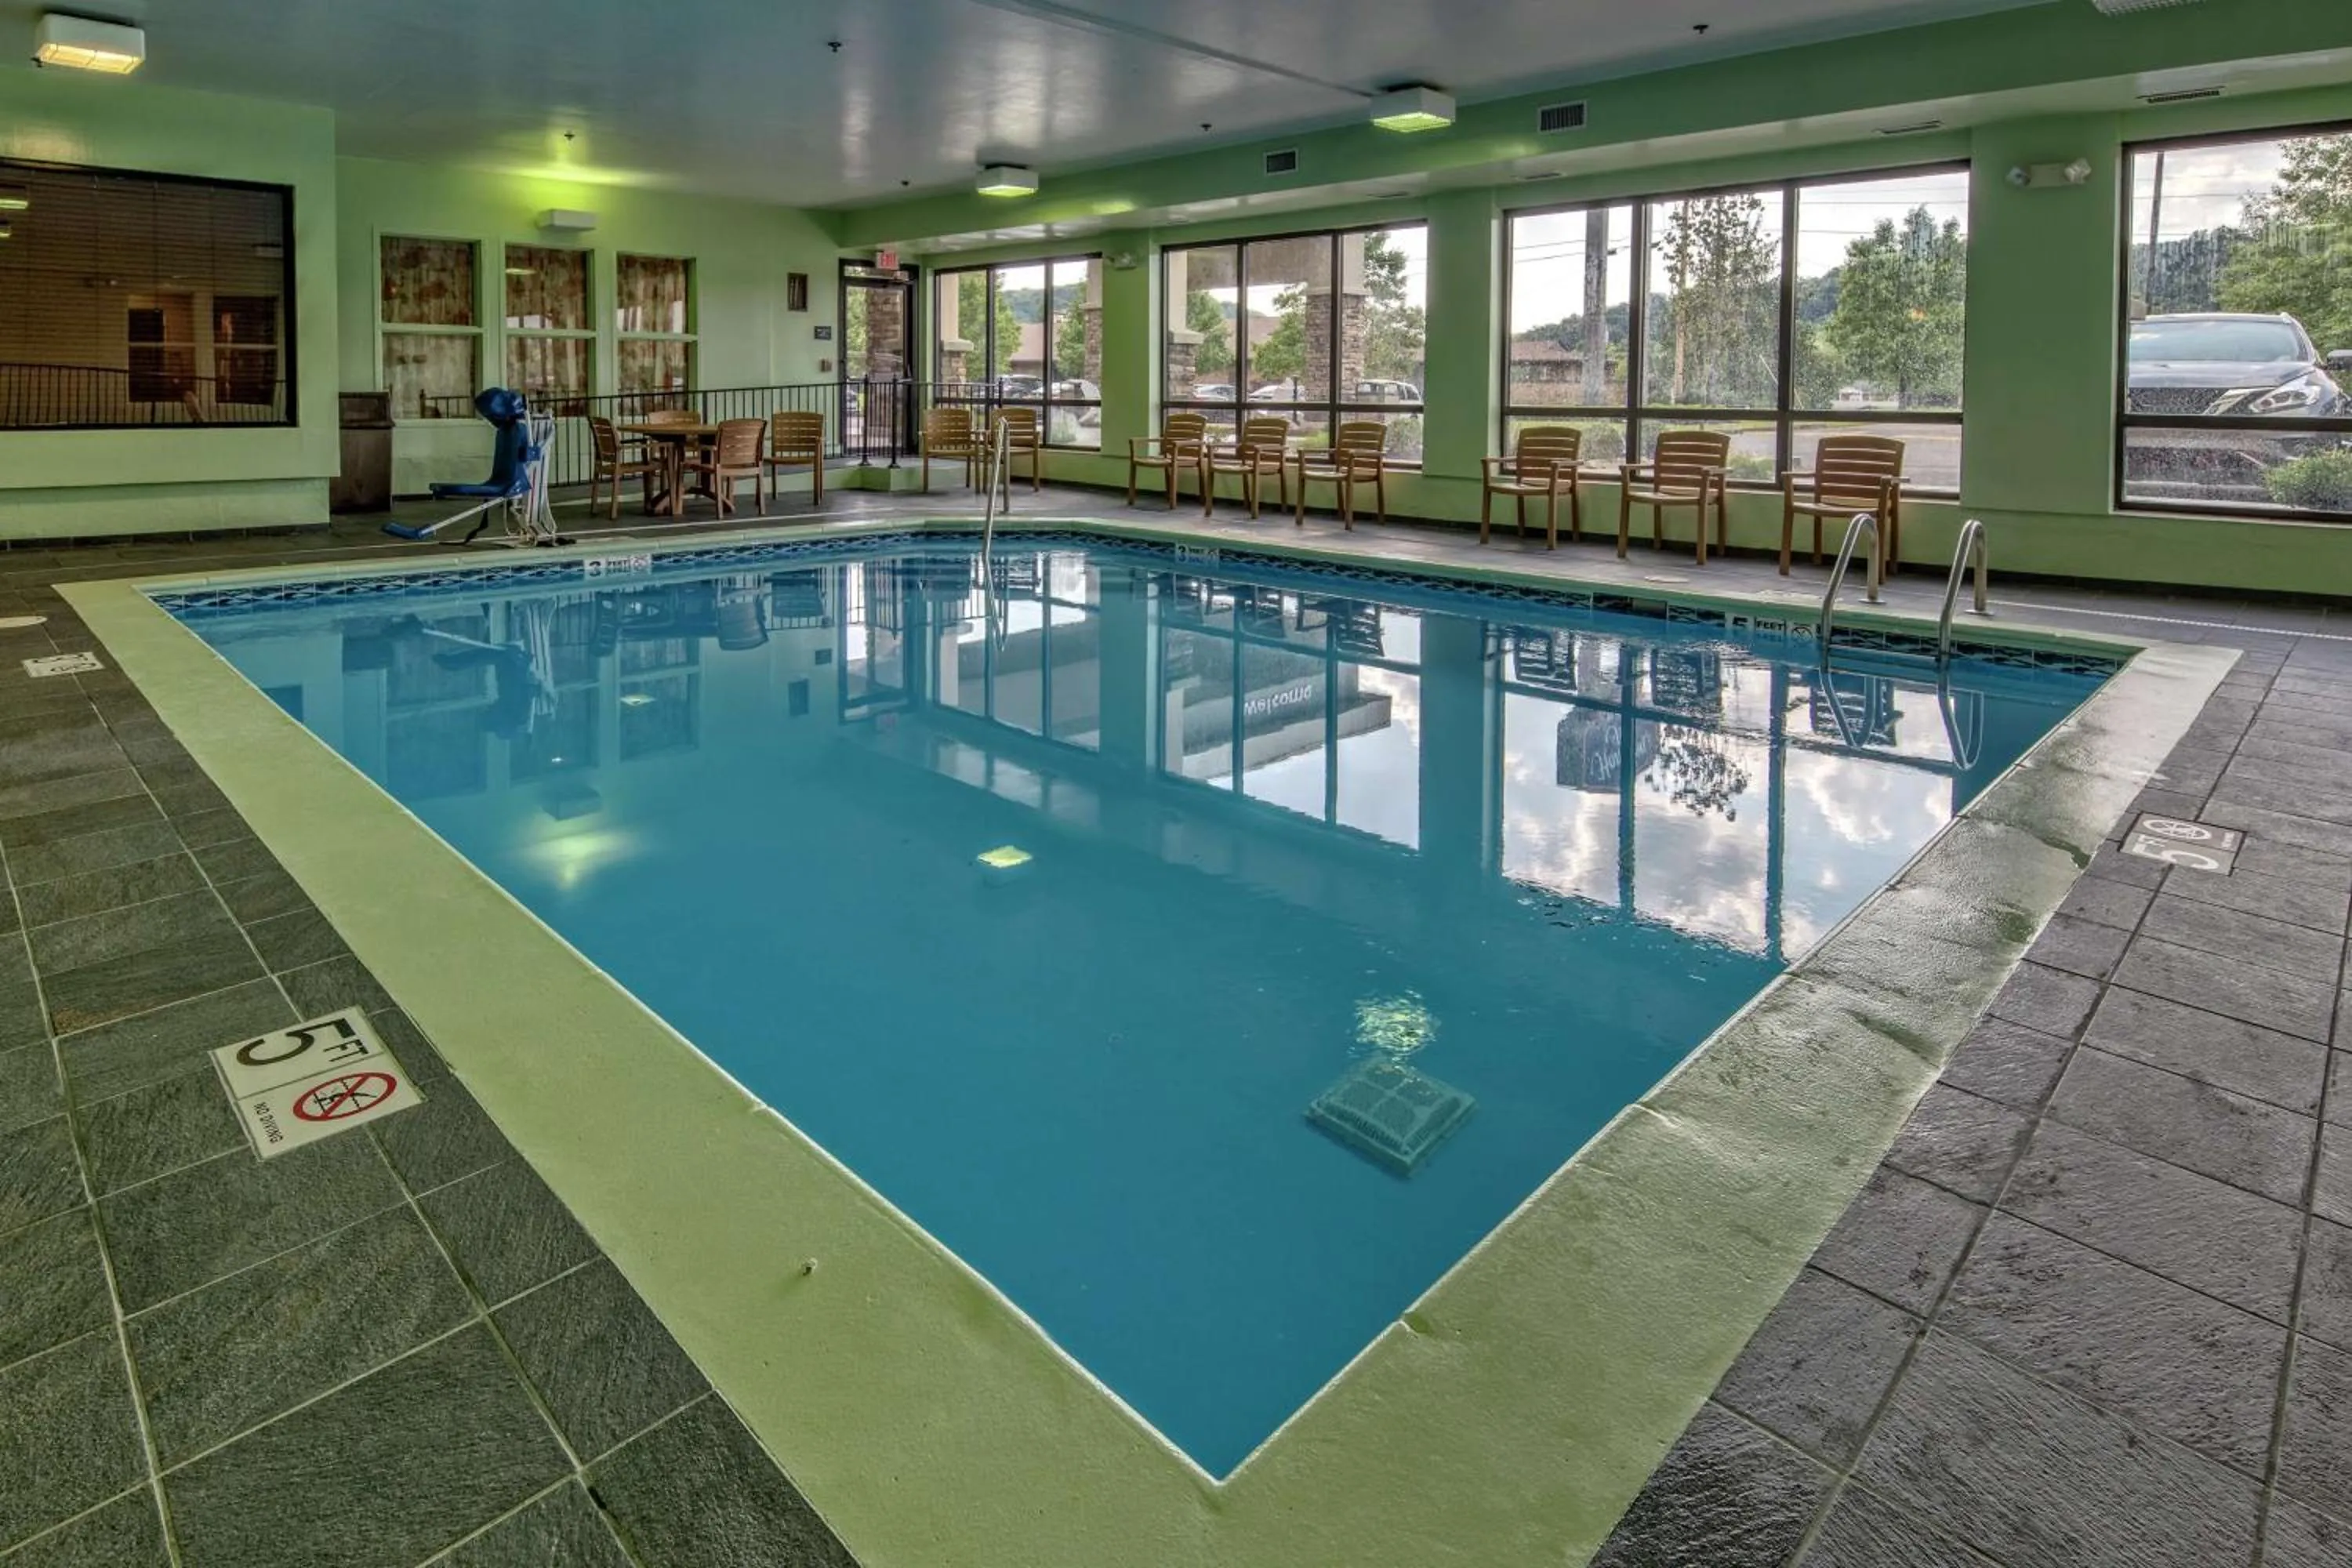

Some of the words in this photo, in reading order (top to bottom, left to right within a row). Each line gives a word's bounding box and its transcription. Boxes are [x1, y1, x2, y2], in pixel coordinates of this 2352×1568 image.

[1757, 620, 1784, 631] FEET
[2132, 841, 2220, 870] 5
[236, 1018, 356, 1067] 5
[322, 1038, 369, 1062] FT
[253, 1102, 270, 1115] NO
[260, 1114, 283, 1143] DIVING
